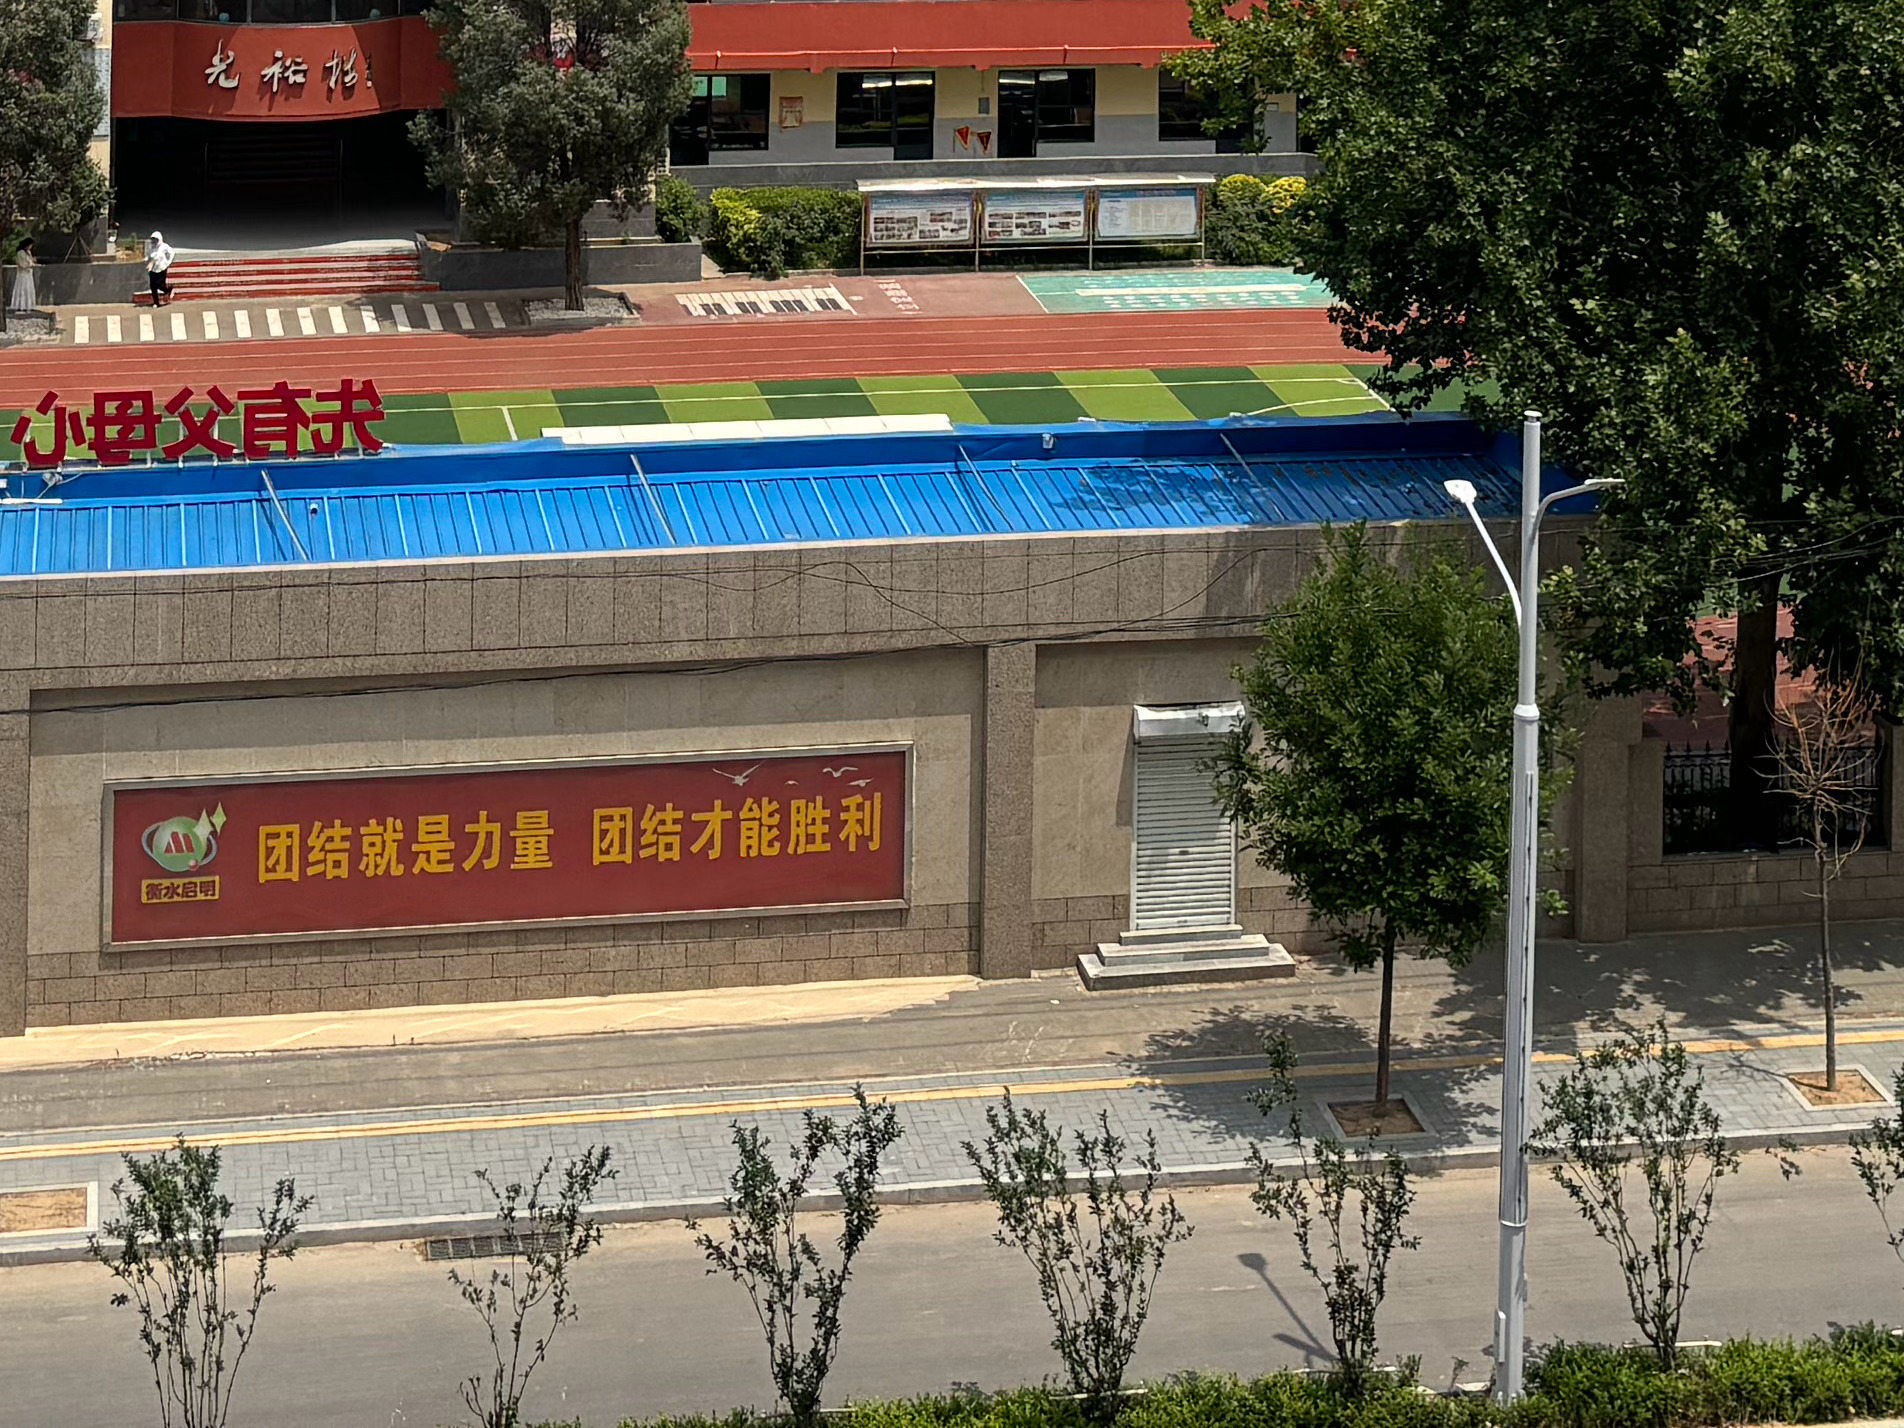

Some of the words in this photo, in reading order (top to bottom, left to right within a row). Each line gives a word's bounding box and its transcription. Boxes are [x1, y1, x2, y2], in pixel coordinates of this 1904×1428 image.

[258, 809, 555, 884] 团结就是力量
[592, 791, 883, 866] 团结才能胜利
[145, 879, 217, 901] 衡水启明
